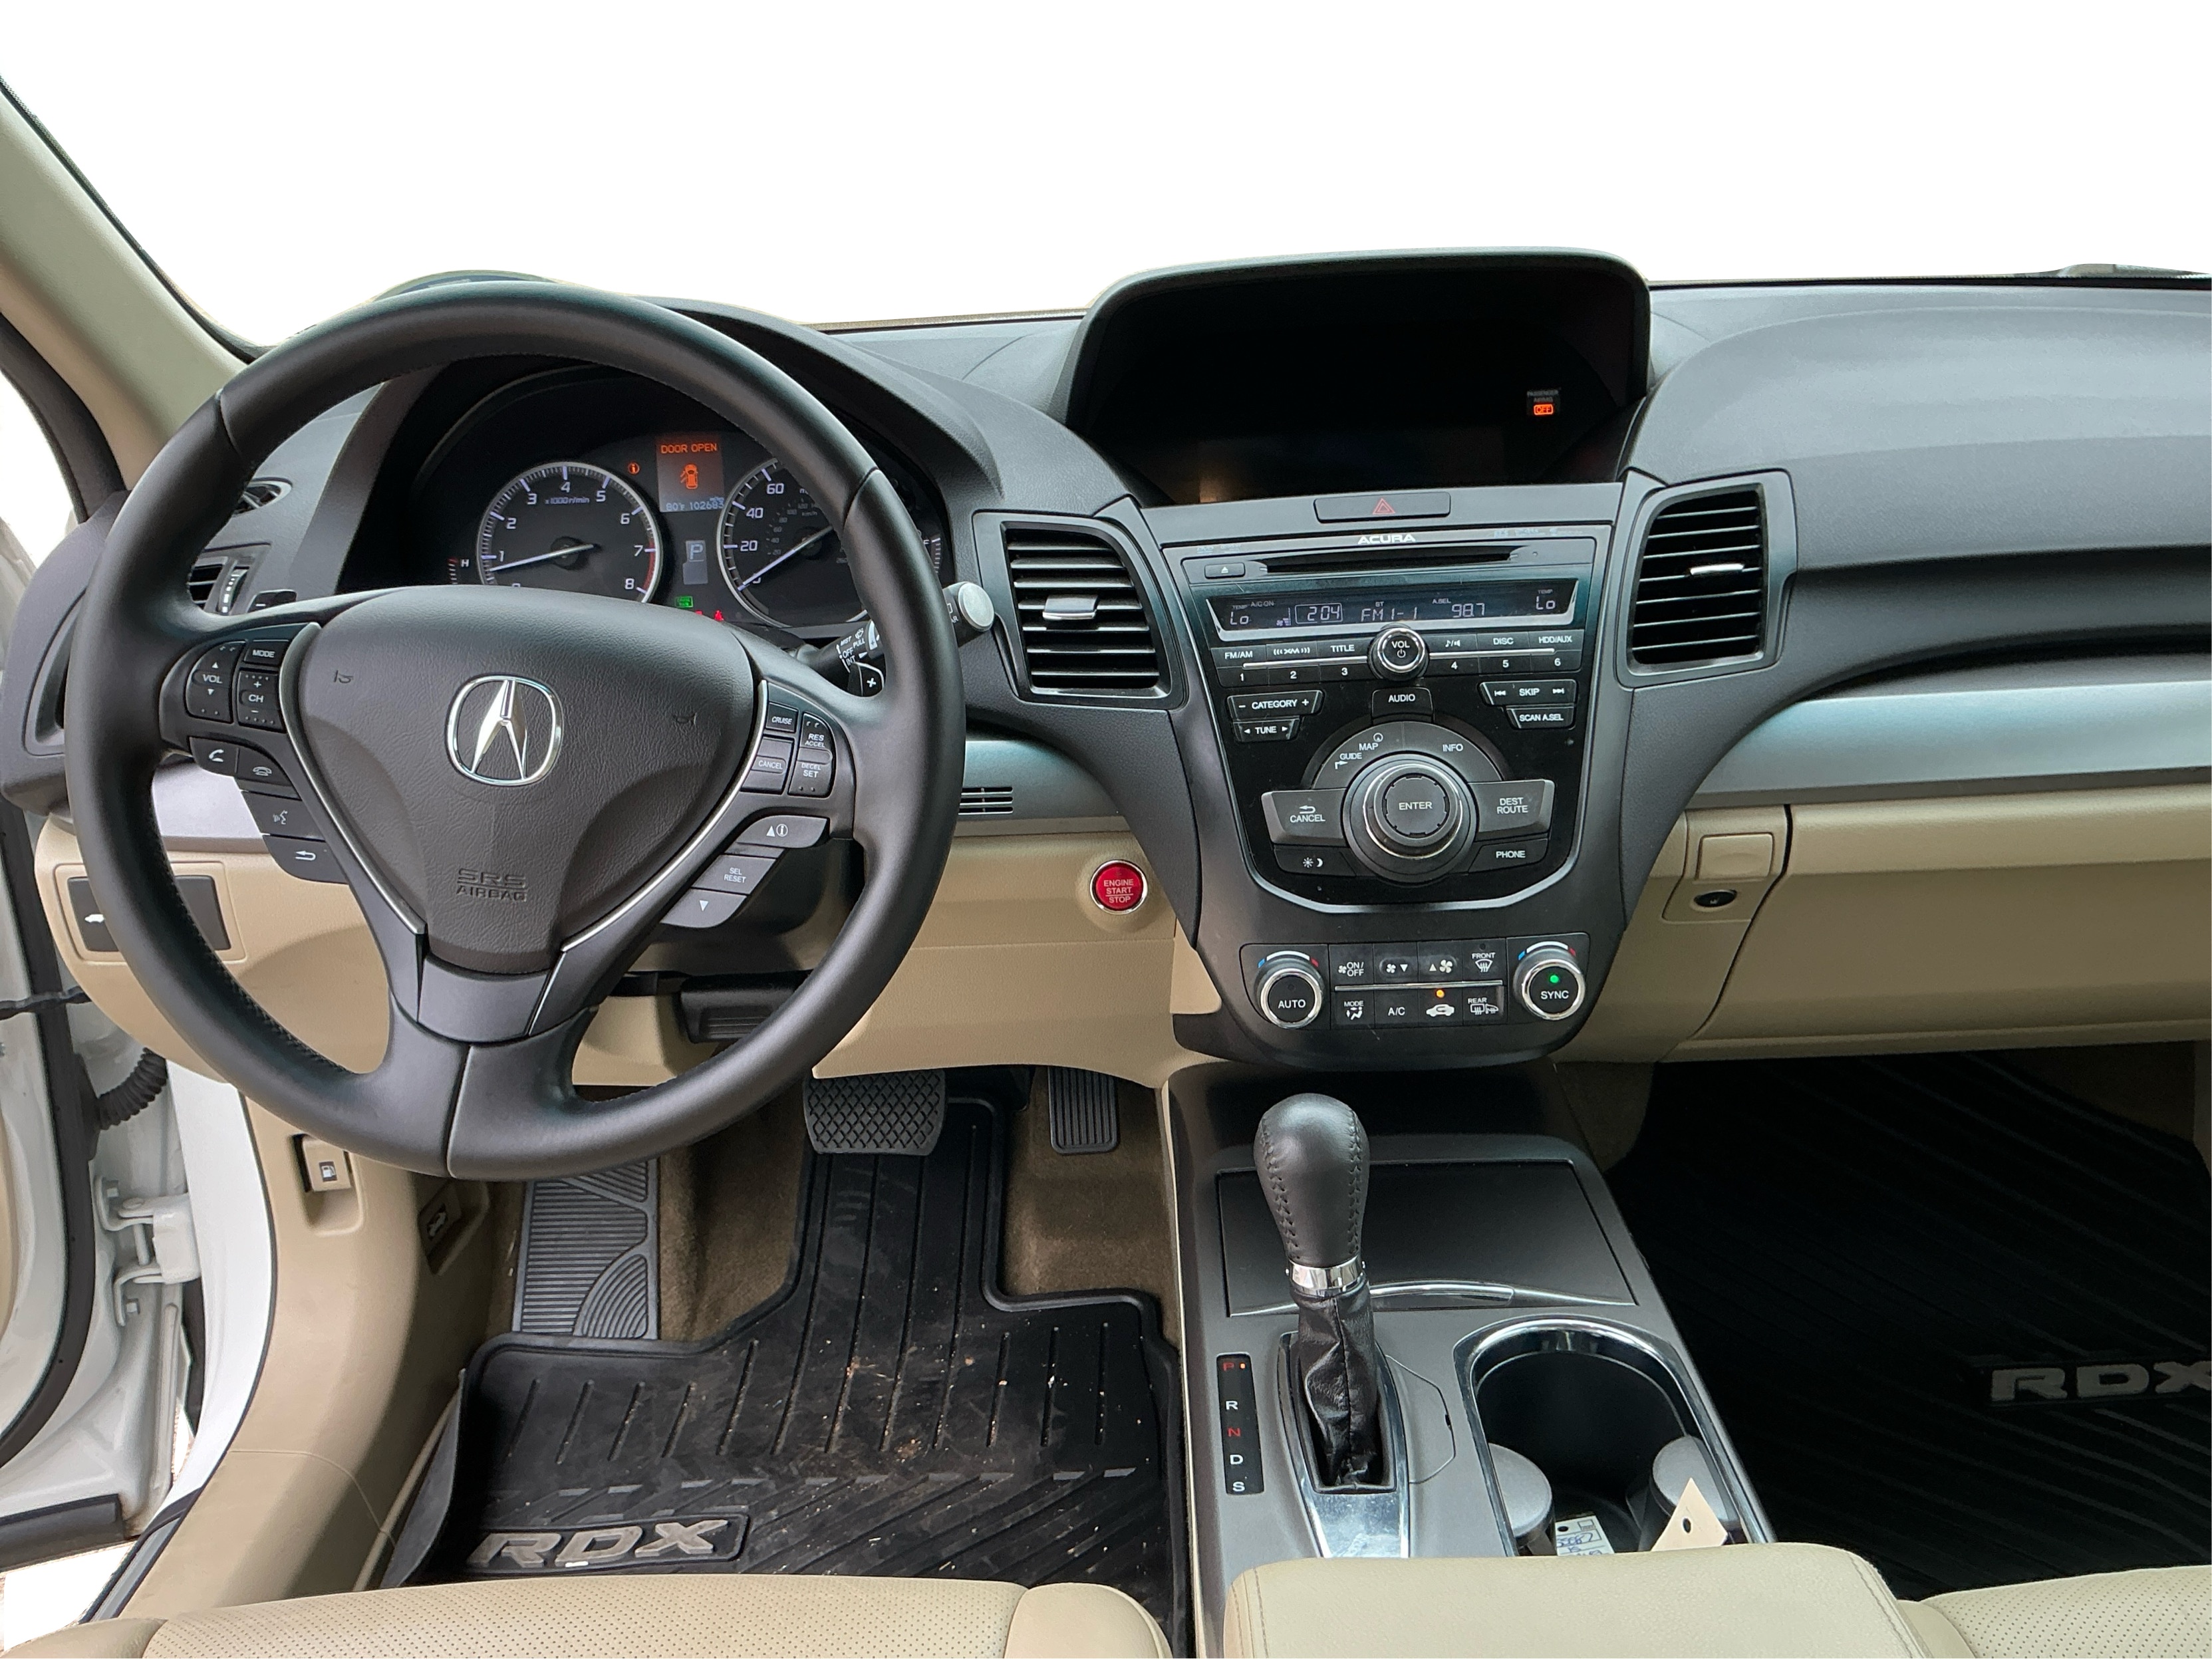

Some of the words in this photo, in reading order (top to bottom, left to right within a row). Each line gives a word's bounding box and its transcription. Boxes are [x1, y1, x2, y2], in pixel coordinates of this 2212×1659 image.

[661, 444, 688, 453] DOOR
[561, 482, 571, 493] 4
[767, 483, 784, 494] 60
[527, 493, 537, 505] 3
[597, 490, 606, 502] 5
[746, 507, 763, 519] 40
[507, 518, 517, 529] 2
[621, 513, 630, 525] 6
[1357, 534, 1416, 545] ACURA
[634, 545, 643, 557] 7
[740, 541, 758, 551] 20
[499, 551, 504, 562] 1
[690, 544, 704, 560] P
[624, 578, 634, 590] 8
[1536, 596, 1556, 610] Lo
[1230, 611, 1249, 625] Lo
[1307, 606, 1341, 621] 204
[853, 638, 866, 649] PULL
[1391, 640, 1410, 649] VOL
[1538, 635, 1573, 644] HDD/AUX
[842, 646, 853, 659] OFF
[1330, 644, 1355, 653] TITLE
[252, 649, 275, 659] MODE
[1224, 650, 1254, 660] FM/AM
[845, 655, 856, 667] INT
[1451, 660, 1458, 670] 4
[1502, 659, 1510, 668] 5
[1554, 658, 1562, 667] 6
[1290, 670, 1297, 680] 2
[1341, 667, 1348, 676] 3
[202, 674, 223, 685] VOL
[1240, 673, 1244, 682] 1
[1519, 688, 1540, 696] SKIP
[248, 694, 264, 704] CH
[1388, 694, 1416, 703] AUDIO
[1251, 699, 1298, 710] CATEGORY
[771, 715, 793, 726] CRUISE
[1519, 713, 1541, 722] SCAN
[1542, 713, 1564, 721] A.SEL
[1255, 725, 1277, 735] TUNE
[807, 733, 825, 743] RES
[1359, 742, 1379, 751] MAP
[1442, 743, 1463, 752] INFO
[1339, 751, 1363, 761] GUIDE
[758, 760, 783, 771] CANCEL
[801, 763, 821, 771] DECEL
[802, 769, 819, 779] SET
[1398, 801, 1433, 811] ENTER
[1499, 797, 1523, 806] DEST
[1496, 805, 1528, 815] ROUTE
[1290, 813, 1325, 823] CANCEL
[1496, 850, 1526, 859] PHONE
[729, 867, 743, 876] SEL
[458, 868, 527, 889] SRS
[723, 874, 746, 884] RESET
[1103, 878, 1134, 887] ENGINE
[456, 885, 527, 902] AIRBAG
[1347, 961, 1364, 970] ON/
[1347, 969, 1364, 977] OFF
[1540, 989, 1570, 1000] SYNC
[1278, 999, 1306, 1009] AUTO
[1387, 1006, 1405, 1016] A/C
[1222, 1362, 1234, 1371] P
[1992, 1360, 2212, 1402] RDX
[1226, 1400, 1238, 1410] R
[1228, 1428, 1241, 1437] N
[1230, 1454, 1244, 1464] D
[1232, 1481, 1245, 1492] S
[468, 1519, 728, 1567] RDX
